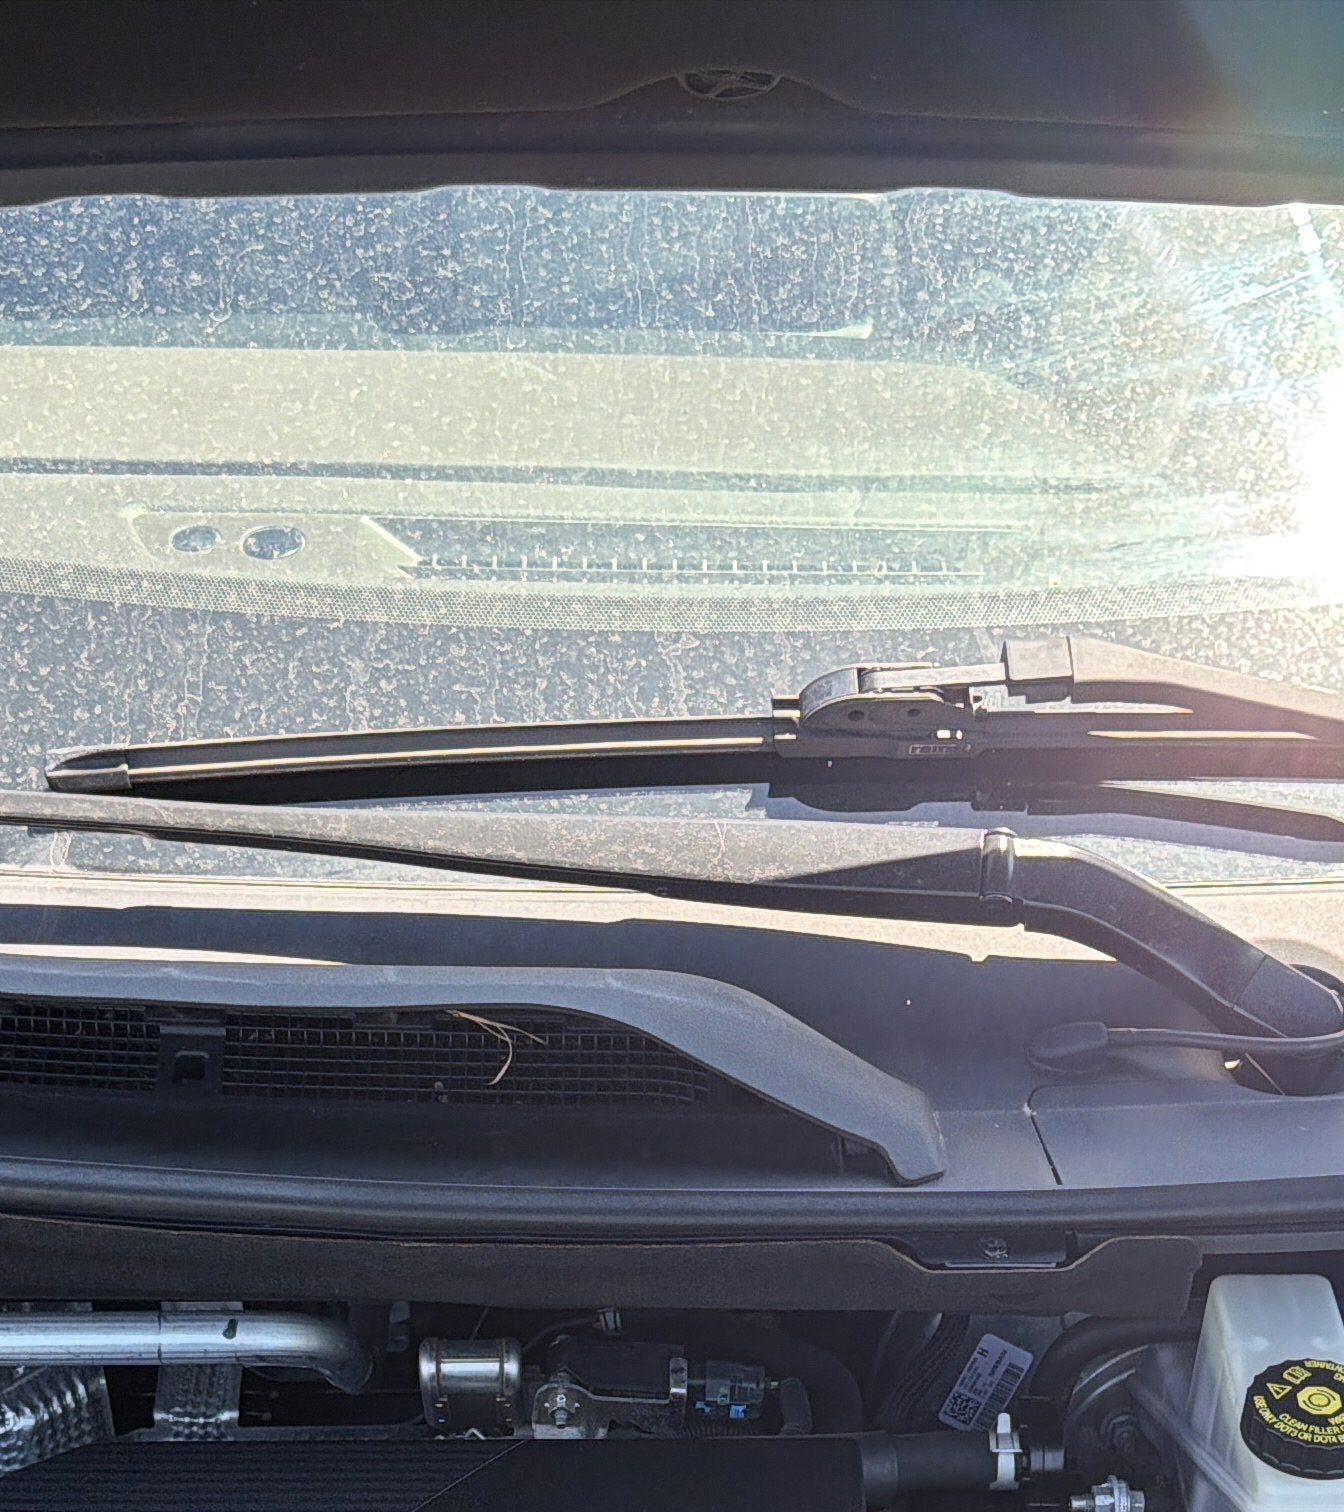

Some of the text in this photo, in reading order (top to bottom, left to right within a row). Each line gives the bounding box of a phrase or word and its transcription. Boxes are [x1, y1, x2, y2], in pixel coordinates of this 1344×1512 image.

[1259, 1407, 1277, 1423] ONLY
[1298, 1430, 1312, 1442] OR
[1279, 1413, 1309, 1432] CLEAN
[1308, 1425, 1340, 1435] FILLER
